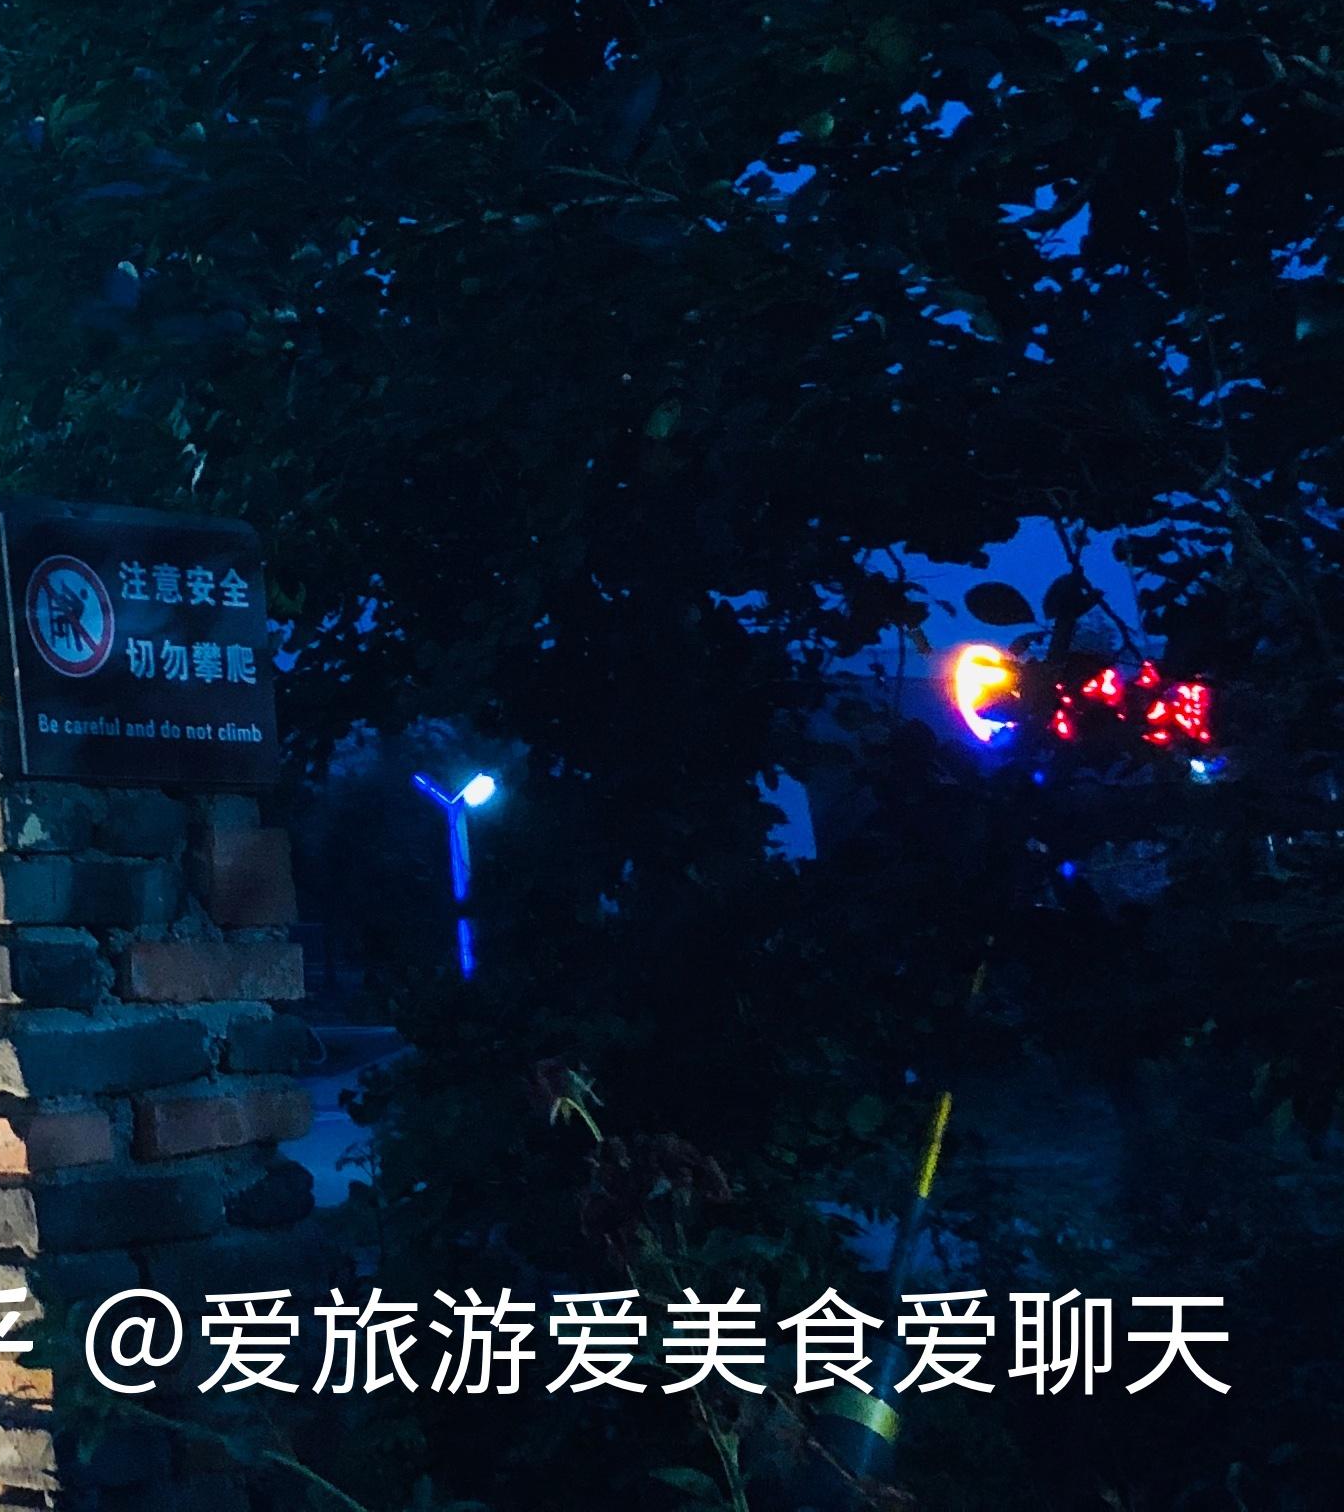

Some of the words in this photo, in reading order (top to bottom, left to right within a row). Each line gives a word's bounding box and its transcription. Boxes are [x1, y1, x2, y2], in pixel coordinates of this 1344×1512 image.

[118, 561, 250, 608] 注意安全
[125, 637, 257, 685] 切勿攀爬
[37, 713, 59, 734] Be
[64, 716, 120, 736] careful
[125, 718, 155, 738] and
[161, 720, 181, 739] do
[186, 722, 212, 740] not
[218, 722, 262, 742] climb
